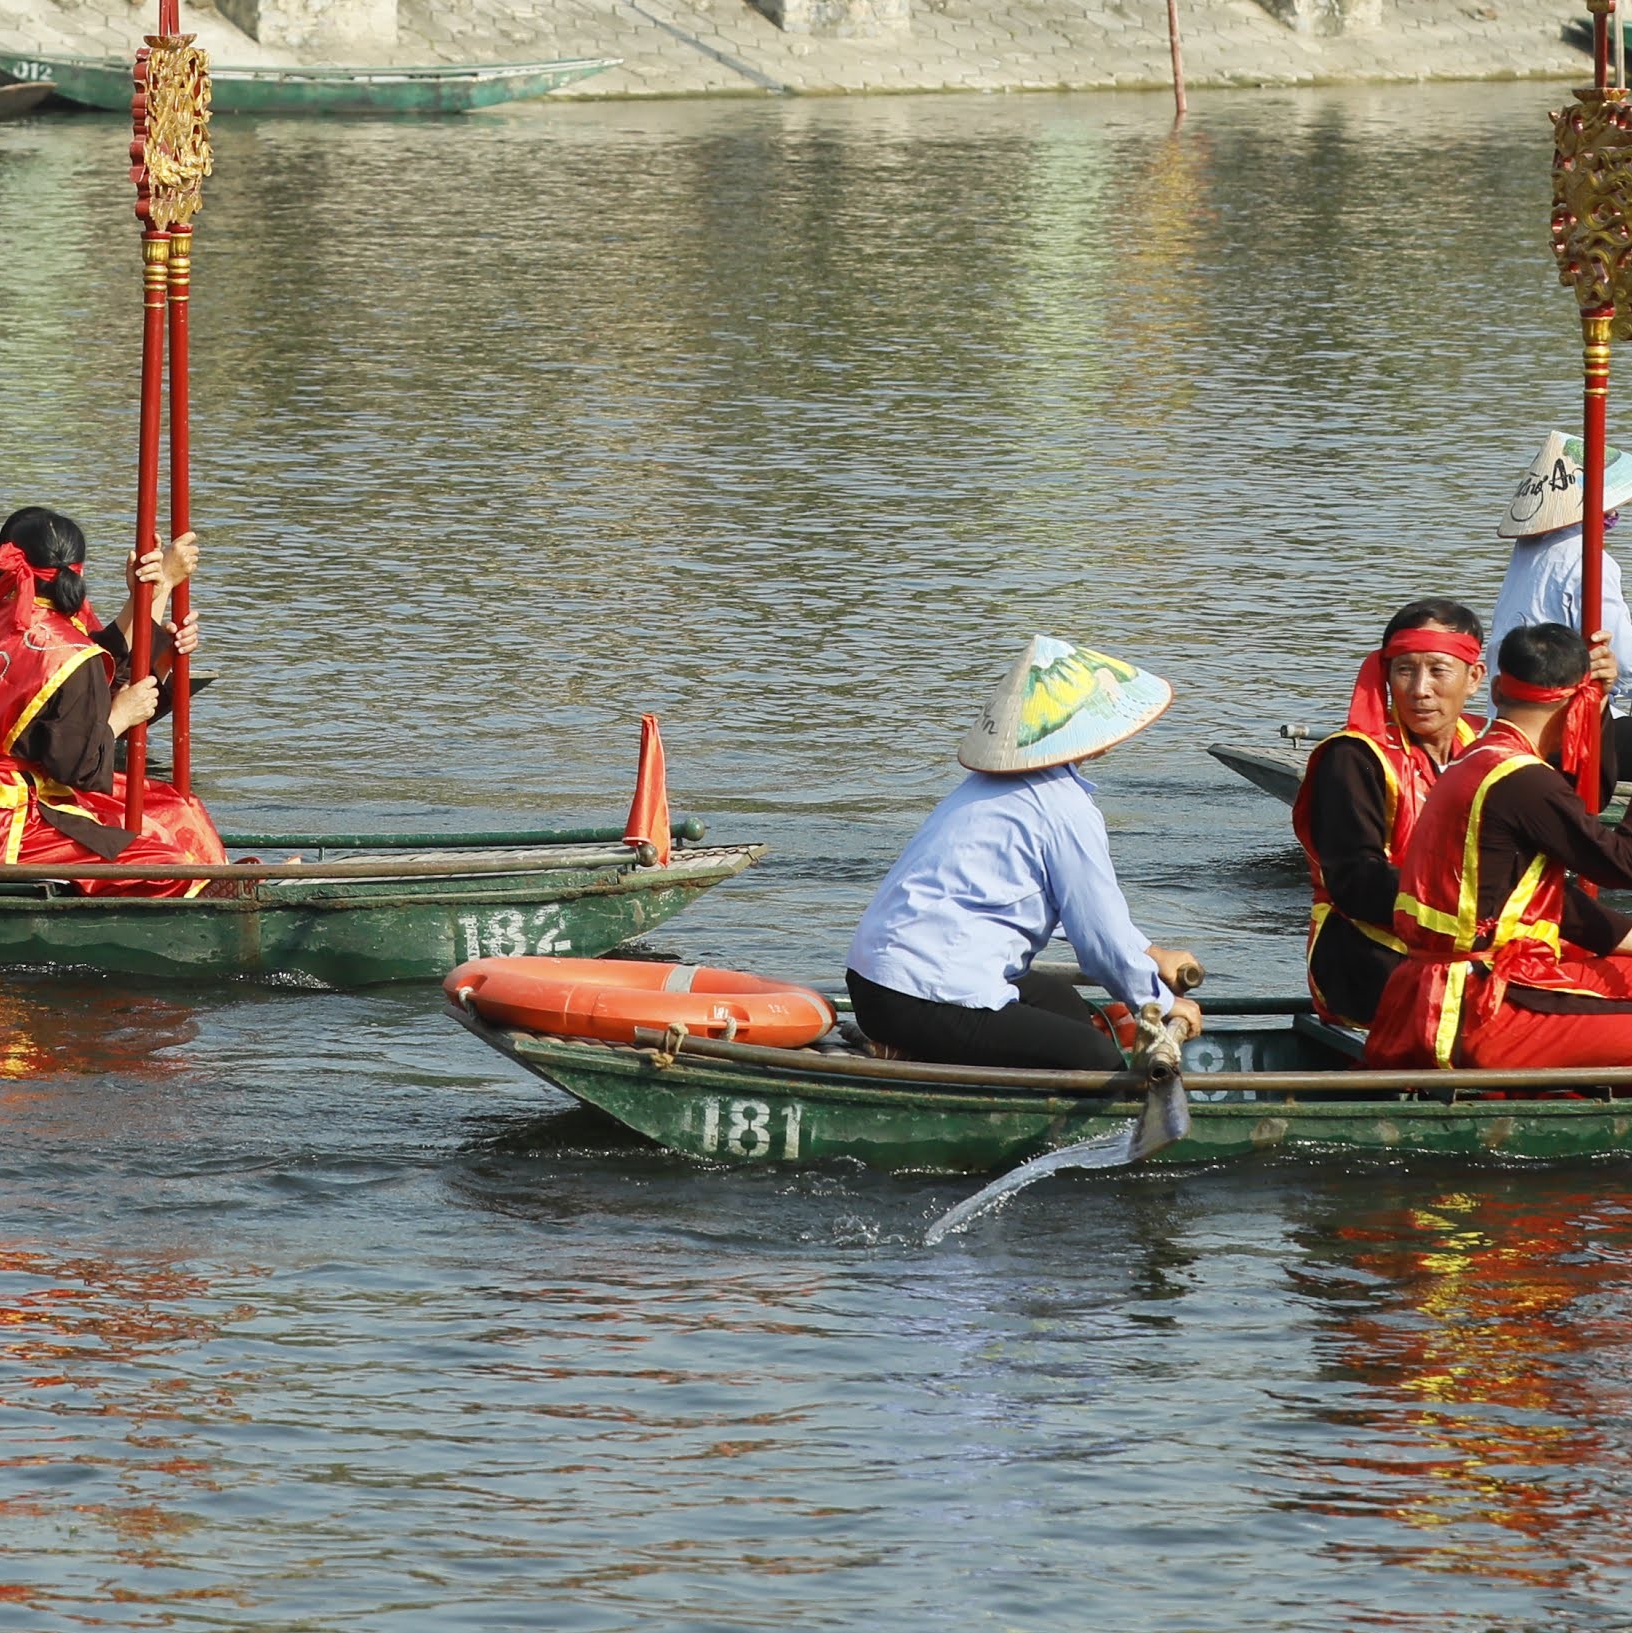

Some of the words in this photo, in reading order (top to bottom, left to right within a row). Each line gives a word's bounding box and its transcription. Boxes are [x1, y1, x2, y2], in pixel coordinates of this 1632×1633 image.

[12, 61, 53, 81] 012
[457, 903, 571, 961] 182
[1186, 1041, 1257, 1102] 81
[702, 1095, 802, 1160] 181
